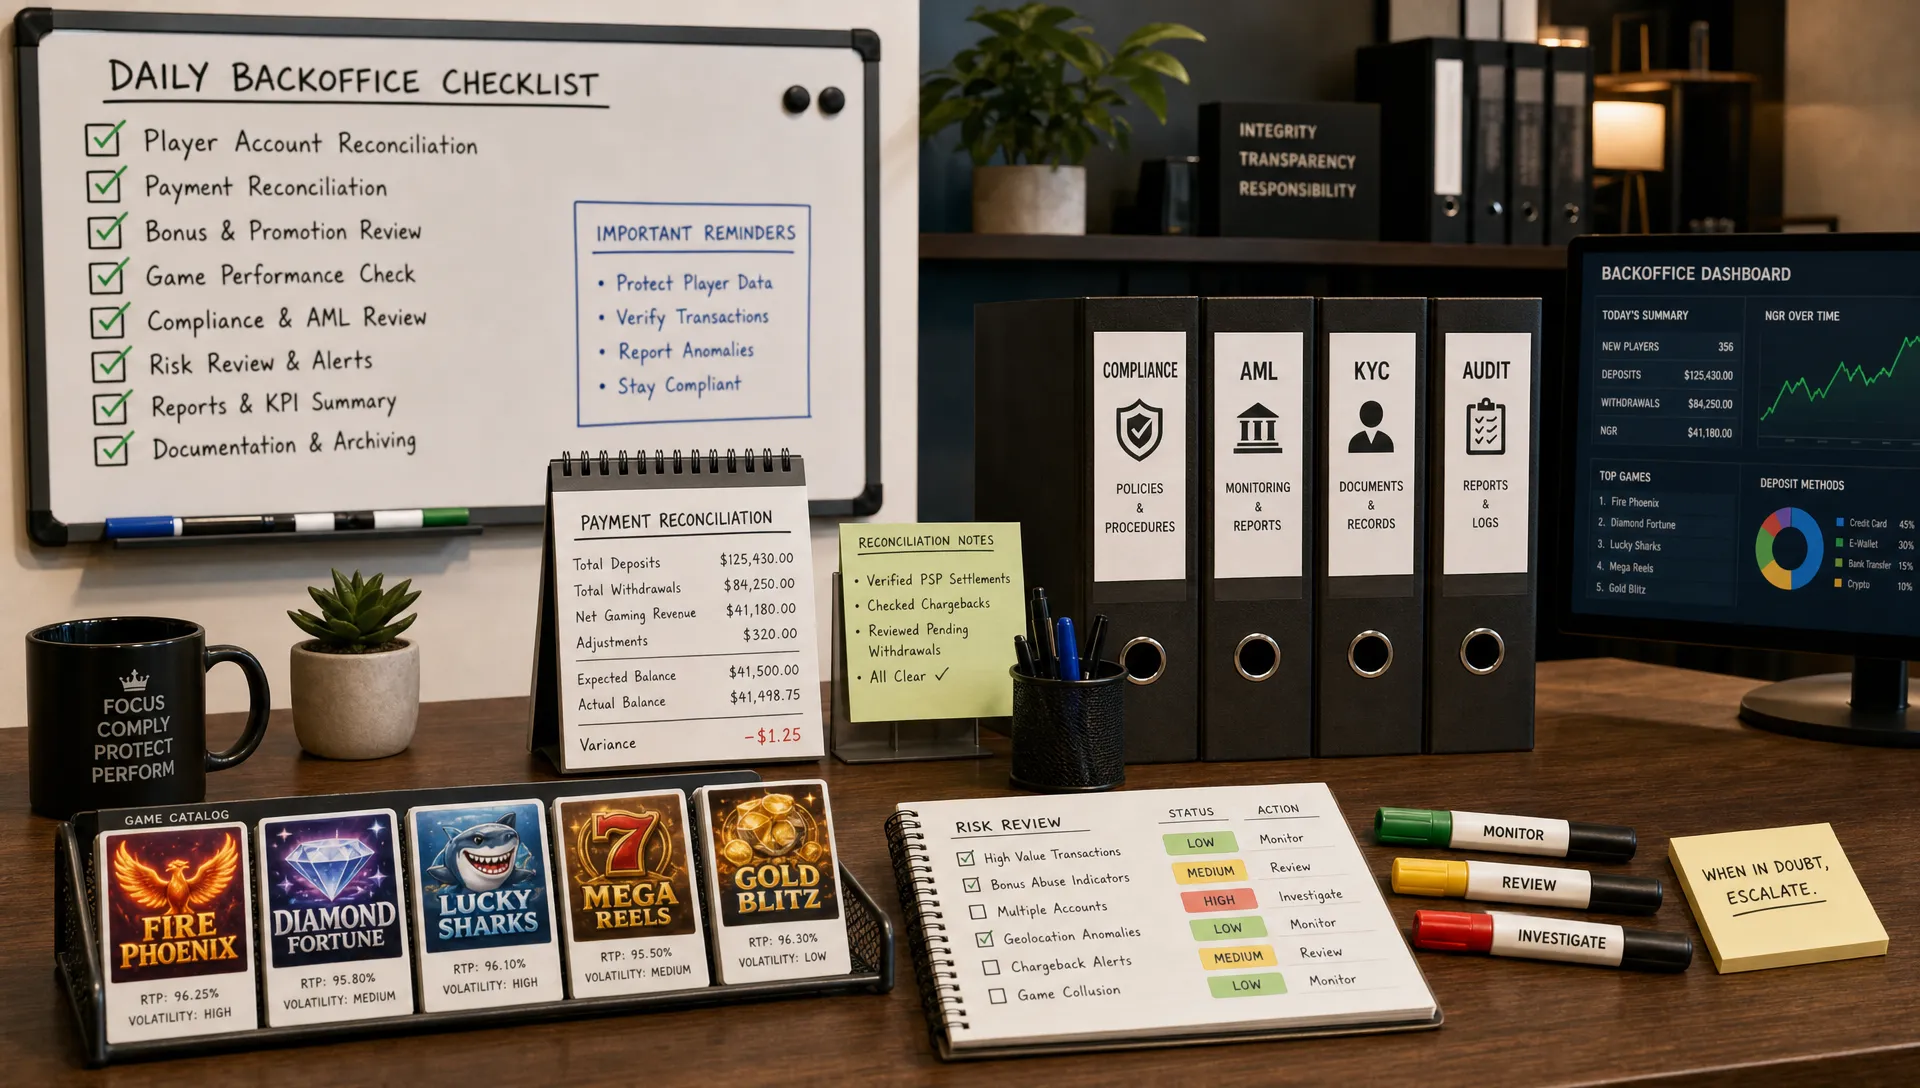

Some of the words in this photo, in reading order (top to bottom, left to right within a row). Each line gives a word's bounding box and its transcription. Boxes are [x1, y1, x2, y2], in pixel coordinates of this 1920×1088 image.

[109, 59, 208, 92] DAILY
[232, 62, 419, 93] BACKOFFICE
[443, 69, 599, 96] CHECKLIST
[1240, 123, 1316, 139] INTEGRITY
[145, 129, 218, 161] Player
[235, 130, 322, 152] Account
[339, 131, 477, 154] Reconciliation
[1240, 151, 1355, 169] TRANSPARENCY
[146, 175, 233, 204] Payment
[249, 175, 387, 196] Reconciliation
[1240, 181, 1356, 197] RESPONSIBILITY
[146, 220, 207, 242] Bonus
[221, 220, 234, 241] &
[250, 220, 346, 240] Promotion
[361, 219, 421, 239] Review
[598, 225, 692, 241] IMPORTANT
[705, 225, 795, 241] REMINDERS
[1602, 266, 1695, 280] BACKOFFICE
[1702, 267, 1791, 281] DASHBOARD
[617, 274, 673, 291] Protect
[684, 274, 729, 297] Player
[738, 274, 773, 290] Data
[148, 310, 264, 338] Compliance
[279, 307, 291, 328] &
[307, 307, 350, 327] AML
[364, 306, 426, 326] Review
[617, 308, 665, 331] Verify
[676, 308, 768, 324] Transactions
[1603, 310, 1639, 320] TODAY'S
[1643, 310, 1688, 320] SUMMARY
[1766, 311, 1785, 320] NGR
[1789, 311, 1813, 320] OVER
[1817, 311, 1839, 321] TIME
[1603, 342, 1621, 351] NEW
[1624, 342, 1659, 351] PLAYERS
[1719, 342, 1733, 351] 356
[1104, 362, 1177, 378] COMPLIANCE
[1240, 361, 1277, 380] AML
[1355, 361, 1389, 380] KYC
[1463, 361, 1510, 379] AUDIT
[1602, 370, 1641, 379] DEPOSITS
[1685, 370, 1733, 380] $125,430.00
[619, 377, 655, 400] Stay
[666, 375, 741, 398] Compliant
[153, 396, 226, 424] Reports
[240, 393, 252, 413] &
[267, 392, 297, 412] KPI
[312, 392, 396, 417] Summary
[1601, 398, 1660, 408] WITHDRAWALS
[1689, 398, 1732, 409] $84,250.00
[1600, 471, 1616, 480] TOP
[1620, 472, 1650, 482] GAMES
[1761, 478, 1798, 488] DEPOSIT
[1801, 479, 1844, 490] METHODS
[1117, 483, 1163, 494] POLICIES
[1226, 482, 1290, 493] MONITORING
[1340, 481, 1403, 492] DOCUMENTS
[1464, 480, 1508, 490] REPORTS
[1600, 496, 1605, 505] 1.
[1612, 497, 1626, 506] Fire
[1629, 497, 1659, 507] Phoenix
[581, 514, 651, 531] PAYMENT
[660, 510, 772, 528] RECONCILIATION
[1106, 521, 1175, 533] PROCEDURES
[1234, 520, 1281, 531] REPORTS
[1348, 518, 1395, 529] RECORDS
[1473, 517, 1498, 528] LOGS
[1598, 517, 1605, 526] 2.
[1611, 518, 1643, 528] Diamond
[1647, 519, 1676, 529] Fortune
[1872, 519, 1887, 528] Card
[1899, 520, 1915, 529] 45%
[859, 536, 949, 548] RECONCILIATION
[959, 535, 993, 545] NOTES
[573, 558, 602, 570] Total
[611, 557, 660, 573] Deposits
[721, 553, 793, 567] $125,430.00
[1849, 559, 1864, 568] Bank
[1899, 562, 1913, 570] 15%
[725, 578, 794, 592] $84,250.00
[867, 573, 912, 586] Verified
[921, 573, 942, 585] PSP
[950, 573, 1010, 584] Settlements
[1848, 579, 1870, 590] Crypto
[1898, 582, 1912, 591] 10%
[574, 584, 603, 596] Total
[611, 581, 681, 595] Withdrawals
[869, 623, 919, 636] Reviewed
[927, 623, 968, 639] Pending
[869, 643, 940, 657] Withdrawals
[870, 670, 886, 683] All
[895, 670, 926, 682] Clear
[104, 695, 164, 714] FOCUS
[579, 697, 614, 710] Actual
[623, 696, 665, 708] Balance
[731, 689, 800, 705] $41,498.75
[98, 716, 170, 737] COMPLY
[95, 738, 173, 760] PROTECT
[580, 738, 636, 751] Variance
[93, 760, 174, 783] PERFORM
[1169, 808, 1214, 818] STATUS
[1259, 805, 1299, 814] ACTION
[125, 814, 162, 825] GAME
[170, 810, 229, 822] CATALOG
[956, 821, 992, 833] RISK
[1002, 817, 1060, 830] REVIEW
[1260, 833, 1303, 844] Monitor
[1484, 825, 1543, 840] MONITOR
[592, 810, 659, 877] 7
[1187, 838, 1214, 848] LOW
[985, 852, 1010, 867] High
[1015, 851, 1046, 861] Value
[1050, 848, 1121, 859] Transactions
[1702, 865, 1746, 881] WHEN
[1753, 863, 1768, 875] IN
[1774, 856, 1828, 873] DOUBT,
[735, 864, 820, 890] GOLD
[1503, 876, 1556, 891] REVIEW
[582, 881, 679, 911] MEGA
[736, 888, 821, 914] BLITZ
[1204, 895, 1235, 906] HIGH
[1279, 889, 1342, 904] Investigate
[1727, 882, 1817, 905] ESCALATE.
[438, 889, 531, 917] LUCKY
[998, 904, 1046, 919] Multiple
[1054, 901, 1107, 913] Accounts
[142, 912, 217, 941] FIRE
[274, 902, 396, 936] DIAMOND
[438, 912, 539, 941] SHARKS
[596, 908, 671, 930] REELS
[1291, 918, 1336, 929] Monitor
[1004, 931, 1075, 944] Geolocation
[1083, 927, 1140, 940] Anomalies
[1214, 923, 1241, 934] LOW
[287, 930, 385, 954] FORTUNE
[749, 936, 772, 947] RTP:
[778, 933, 818, 945] 96.30%
[1519, 929, 1606, 949] INVESTIGATE
[119, 935, 238, 969] PHOENIX
[739, 954, 798, 967] VOLATILITY:
[805, 951, 826, 962] LOW
[454, 963, 478, 974] RTP:
[485, 959, 526, 971] 96.10%
[141, 993, 166, 1005] RTP:
[175, 988, 219, 1001] 96.25%
[129, 1011, 197, 1026] VOLATILITY:
[205, 1007, 231, 1019] HIGH
